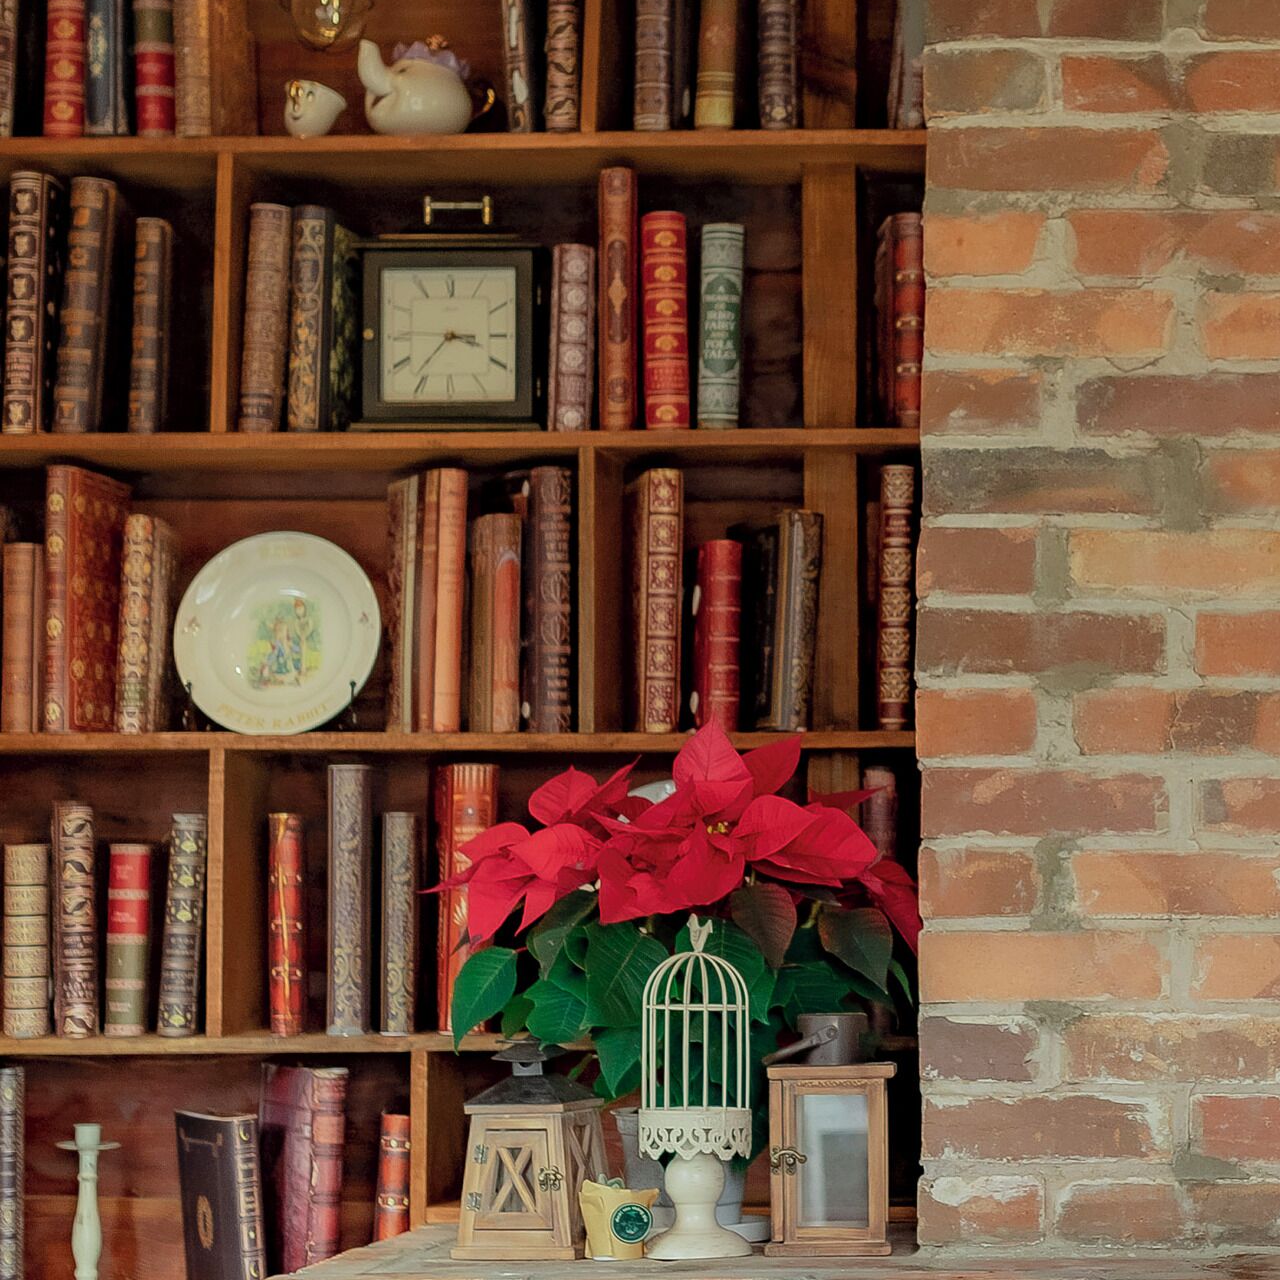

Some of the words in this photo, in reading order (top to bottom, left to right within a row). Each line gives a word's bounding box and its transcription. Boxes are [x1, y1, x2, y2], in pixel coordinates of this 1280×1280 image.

[704, 320, 737, 331] FAIRY
[704, 339, 735, 349] FOLK
[704, 349, 737, 359] TALES
[271, 703, 328, 729] RABBIT
